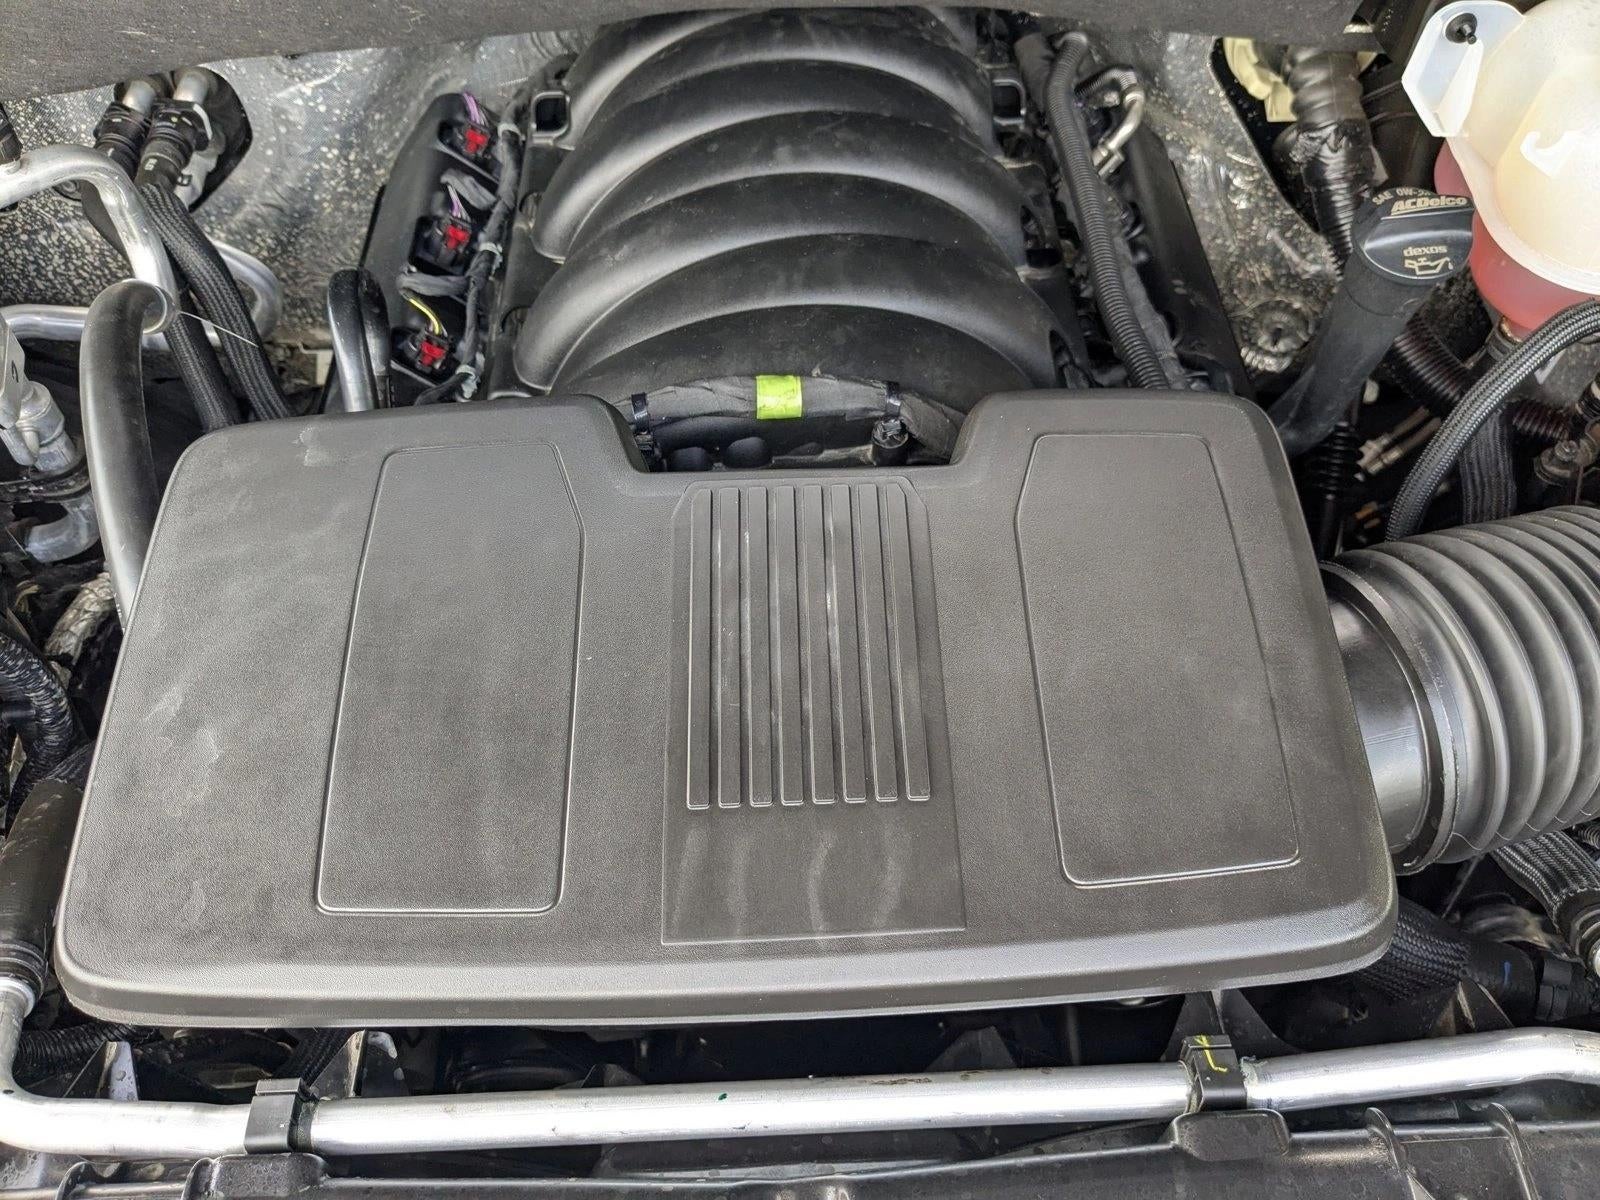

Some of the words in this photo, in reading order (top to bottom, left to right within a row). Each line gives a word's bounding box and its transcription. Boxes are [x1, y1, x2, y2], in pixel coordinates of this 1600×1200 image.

[1372, 190, 1394, 205] SAE
[1391, 195, 1468, 213] ACDelco
[1403, 246, 1448, 257] dexos
